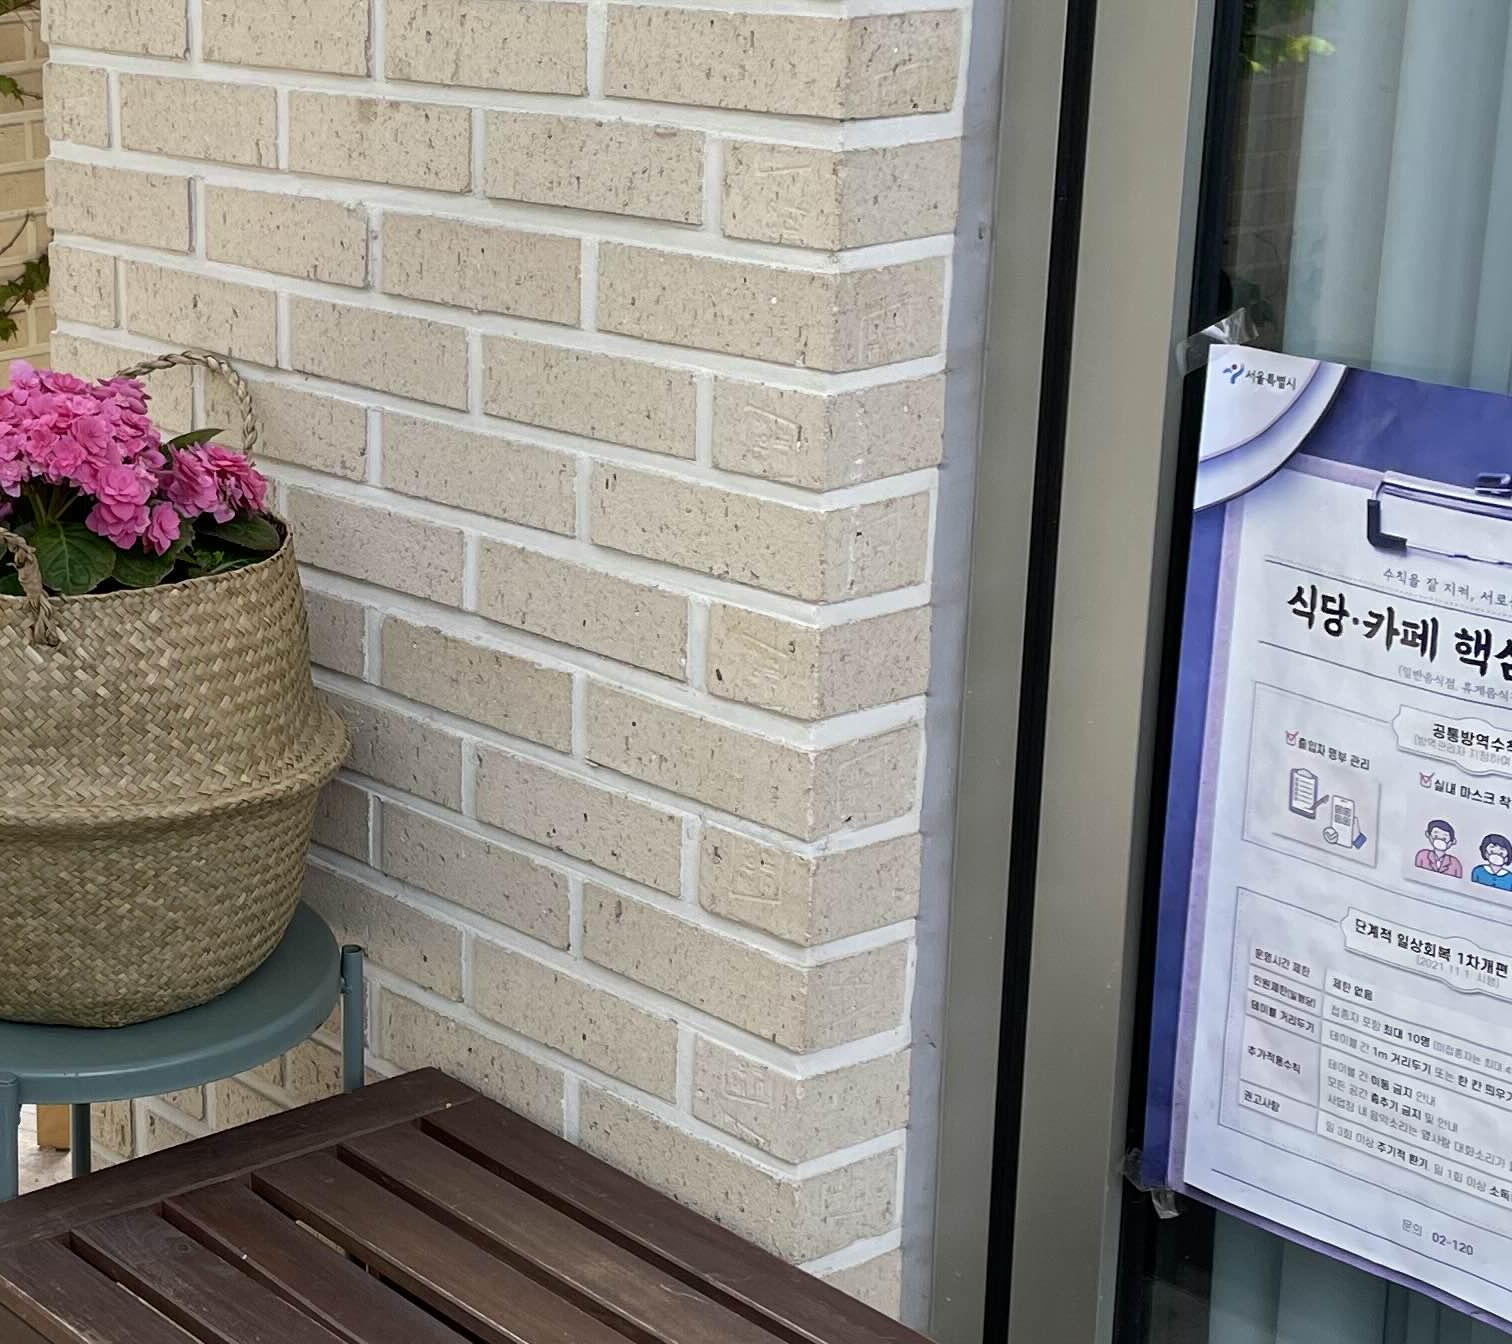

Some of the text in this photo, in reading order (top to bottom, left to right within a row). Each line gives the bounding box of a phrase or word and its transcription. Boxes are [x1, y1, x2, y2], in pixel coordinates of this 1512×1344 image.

[1245, 369, 1297, 390] 서울특별시
[1383, 568, 1420, 588] 수칙을
[1426, 577, 1439, 592] 잘
[1480, 590, 1512, 606] 서로
[1288, 584, 1439, 663] 식당·카페
[1461, 682, 1512, 702] 휴게음식
[1434, 779, 1456, 795] 실내
[1460, 785, 1495, 805] 마스크
[1355, 918, 1508, 978] 단계적 일상회복 1차개편
[1407, 1032, 1430, 1047] 10명
[1373, 1046, 1388, 1060] 1m
[1390, 1052, 1431, 1075] 거리두기
[1489, 1185, 1512, 1202] 소독
[1402, 1219, 1473, 1256] 문의 02-120
